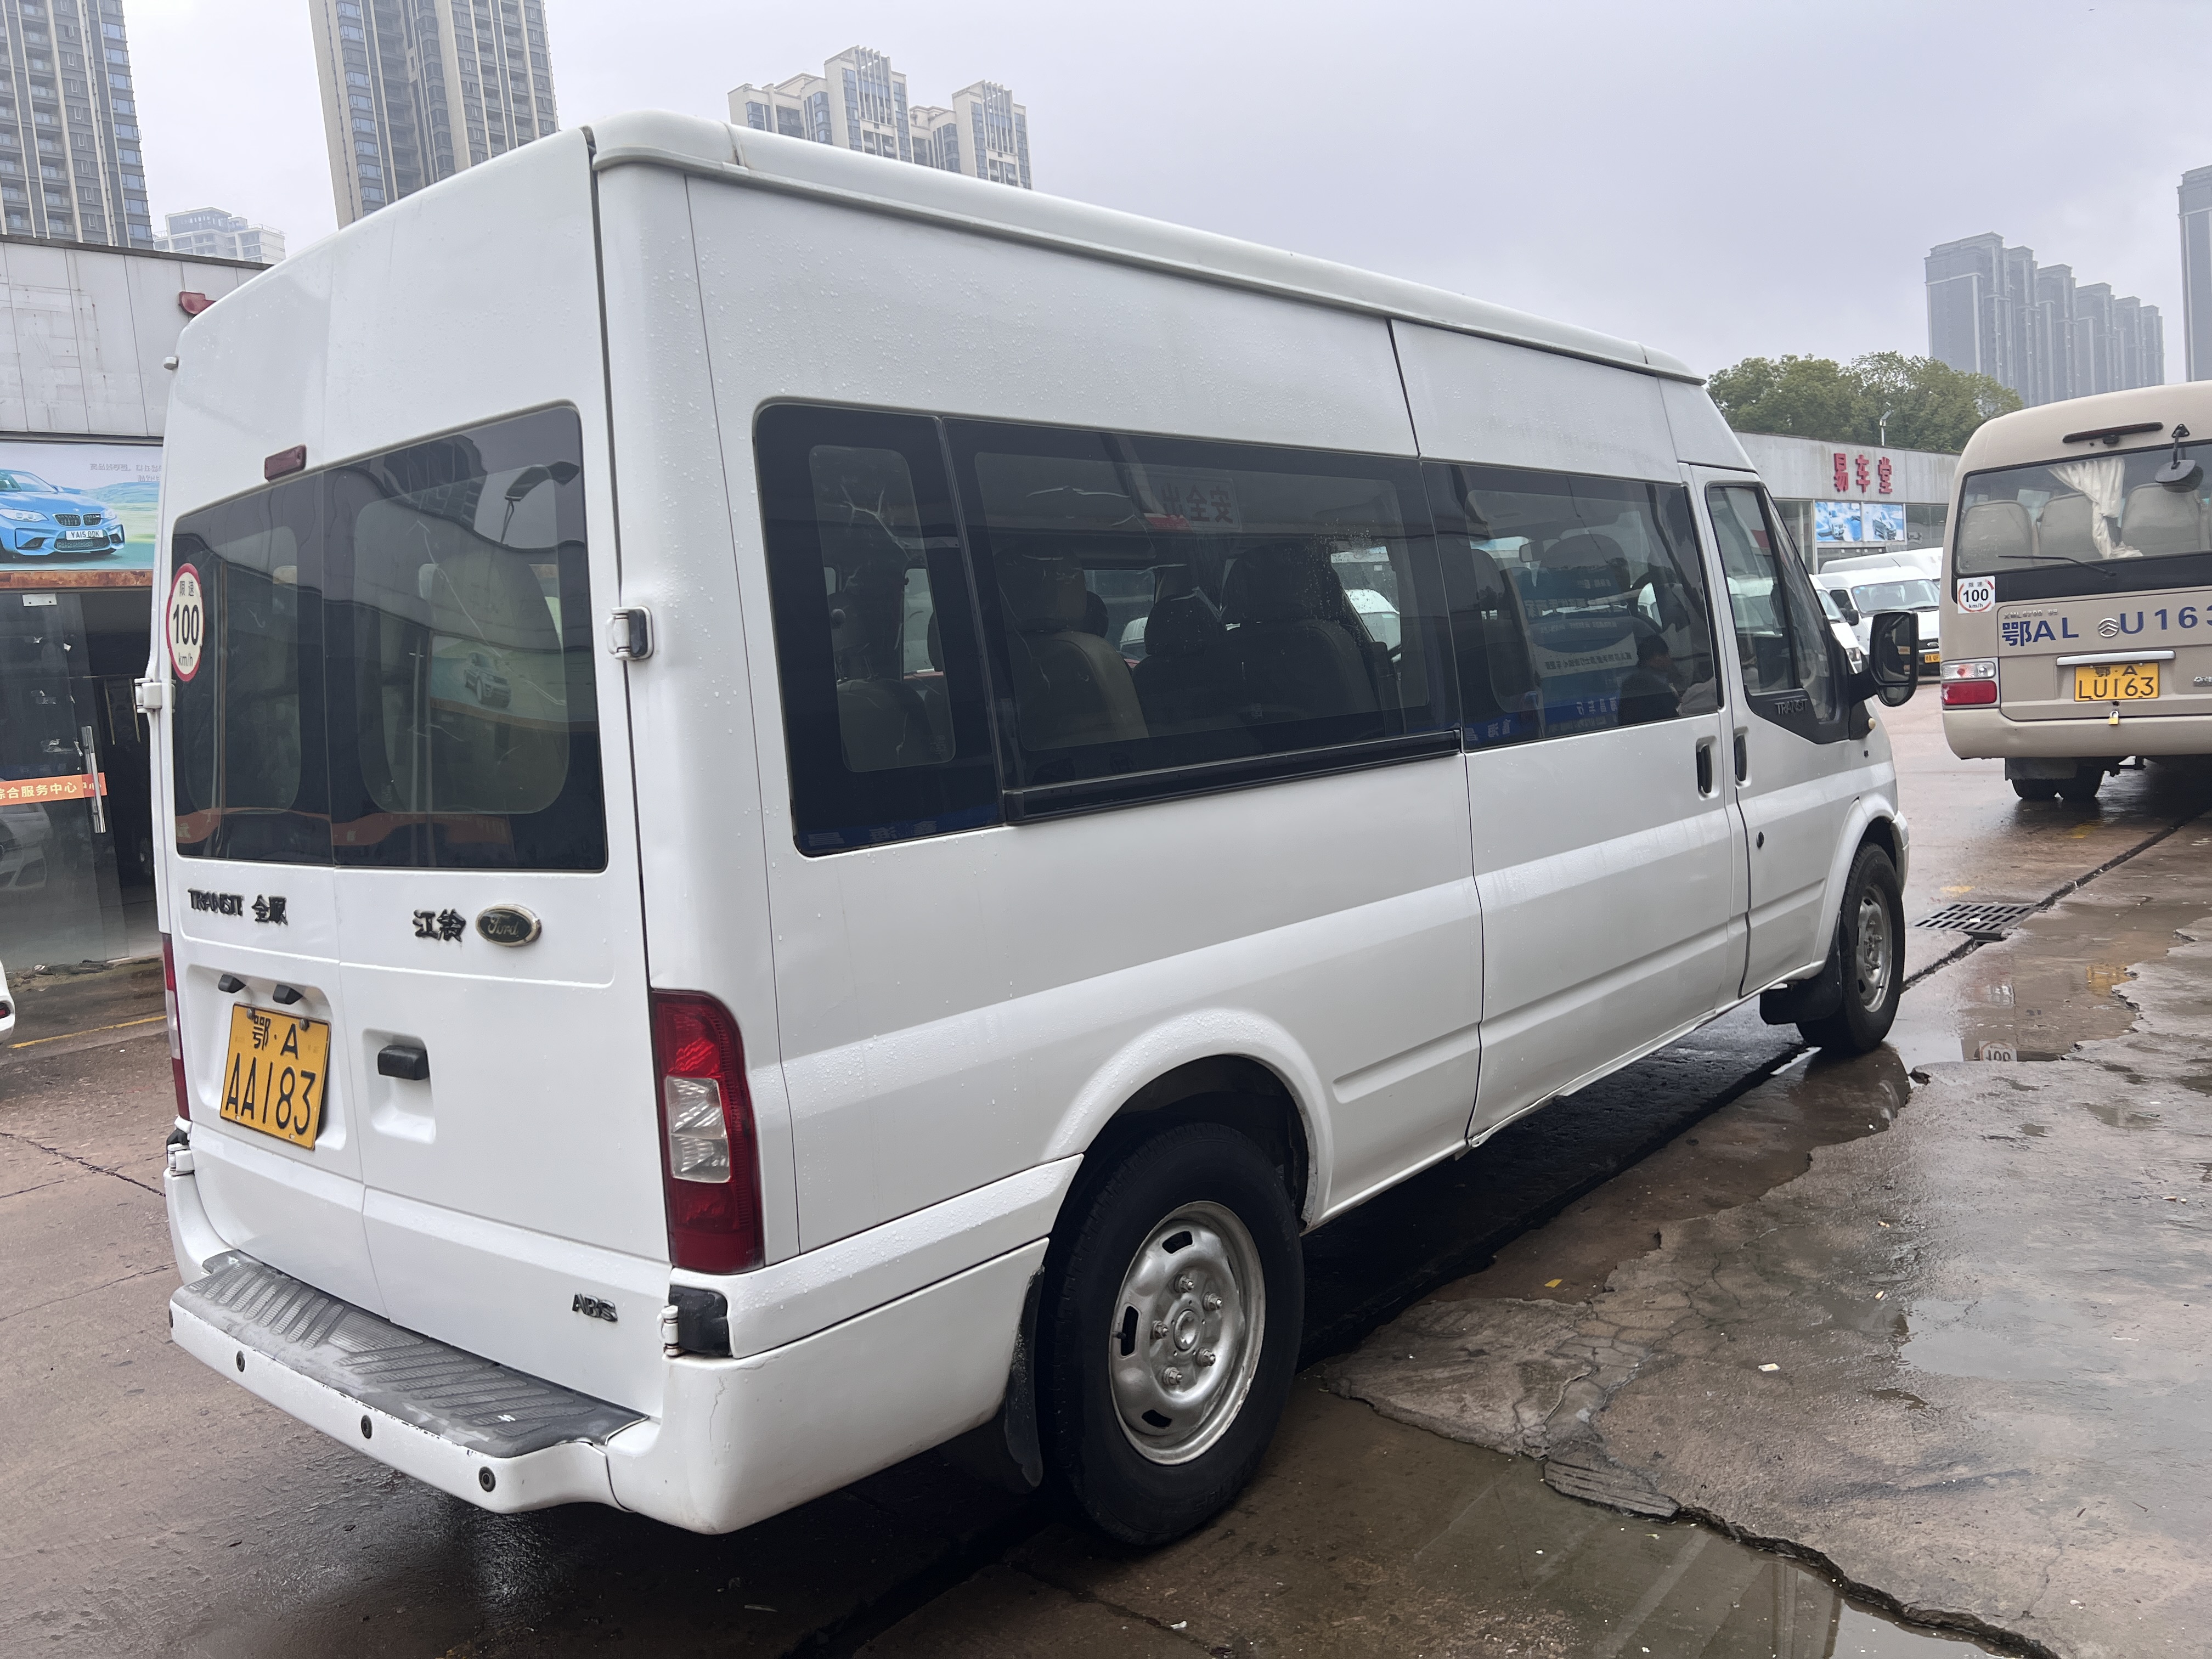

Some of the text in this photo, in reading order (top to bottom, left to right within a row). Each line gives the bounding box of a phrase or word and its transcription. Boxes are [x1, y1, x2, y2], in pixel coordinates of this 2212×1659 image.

[1833, 453, 1893, 494] 易车堂
[179, 580, 194, 597] 限速
[1963, 589, 1989, 602] 100
[173, 604, 199, 645] 100
[2002, 617, 2079, 646] 鄂AL
[178, 652, 194, 667] km/h
[2079, 677, 2154, 699] LU163
[251, 894, 289, 927] 全顺
[413, 909, 466, 943] 江铃
[225, 1052, 317, 1136] AA183
[572, 1292, 618, 1322] ABS
